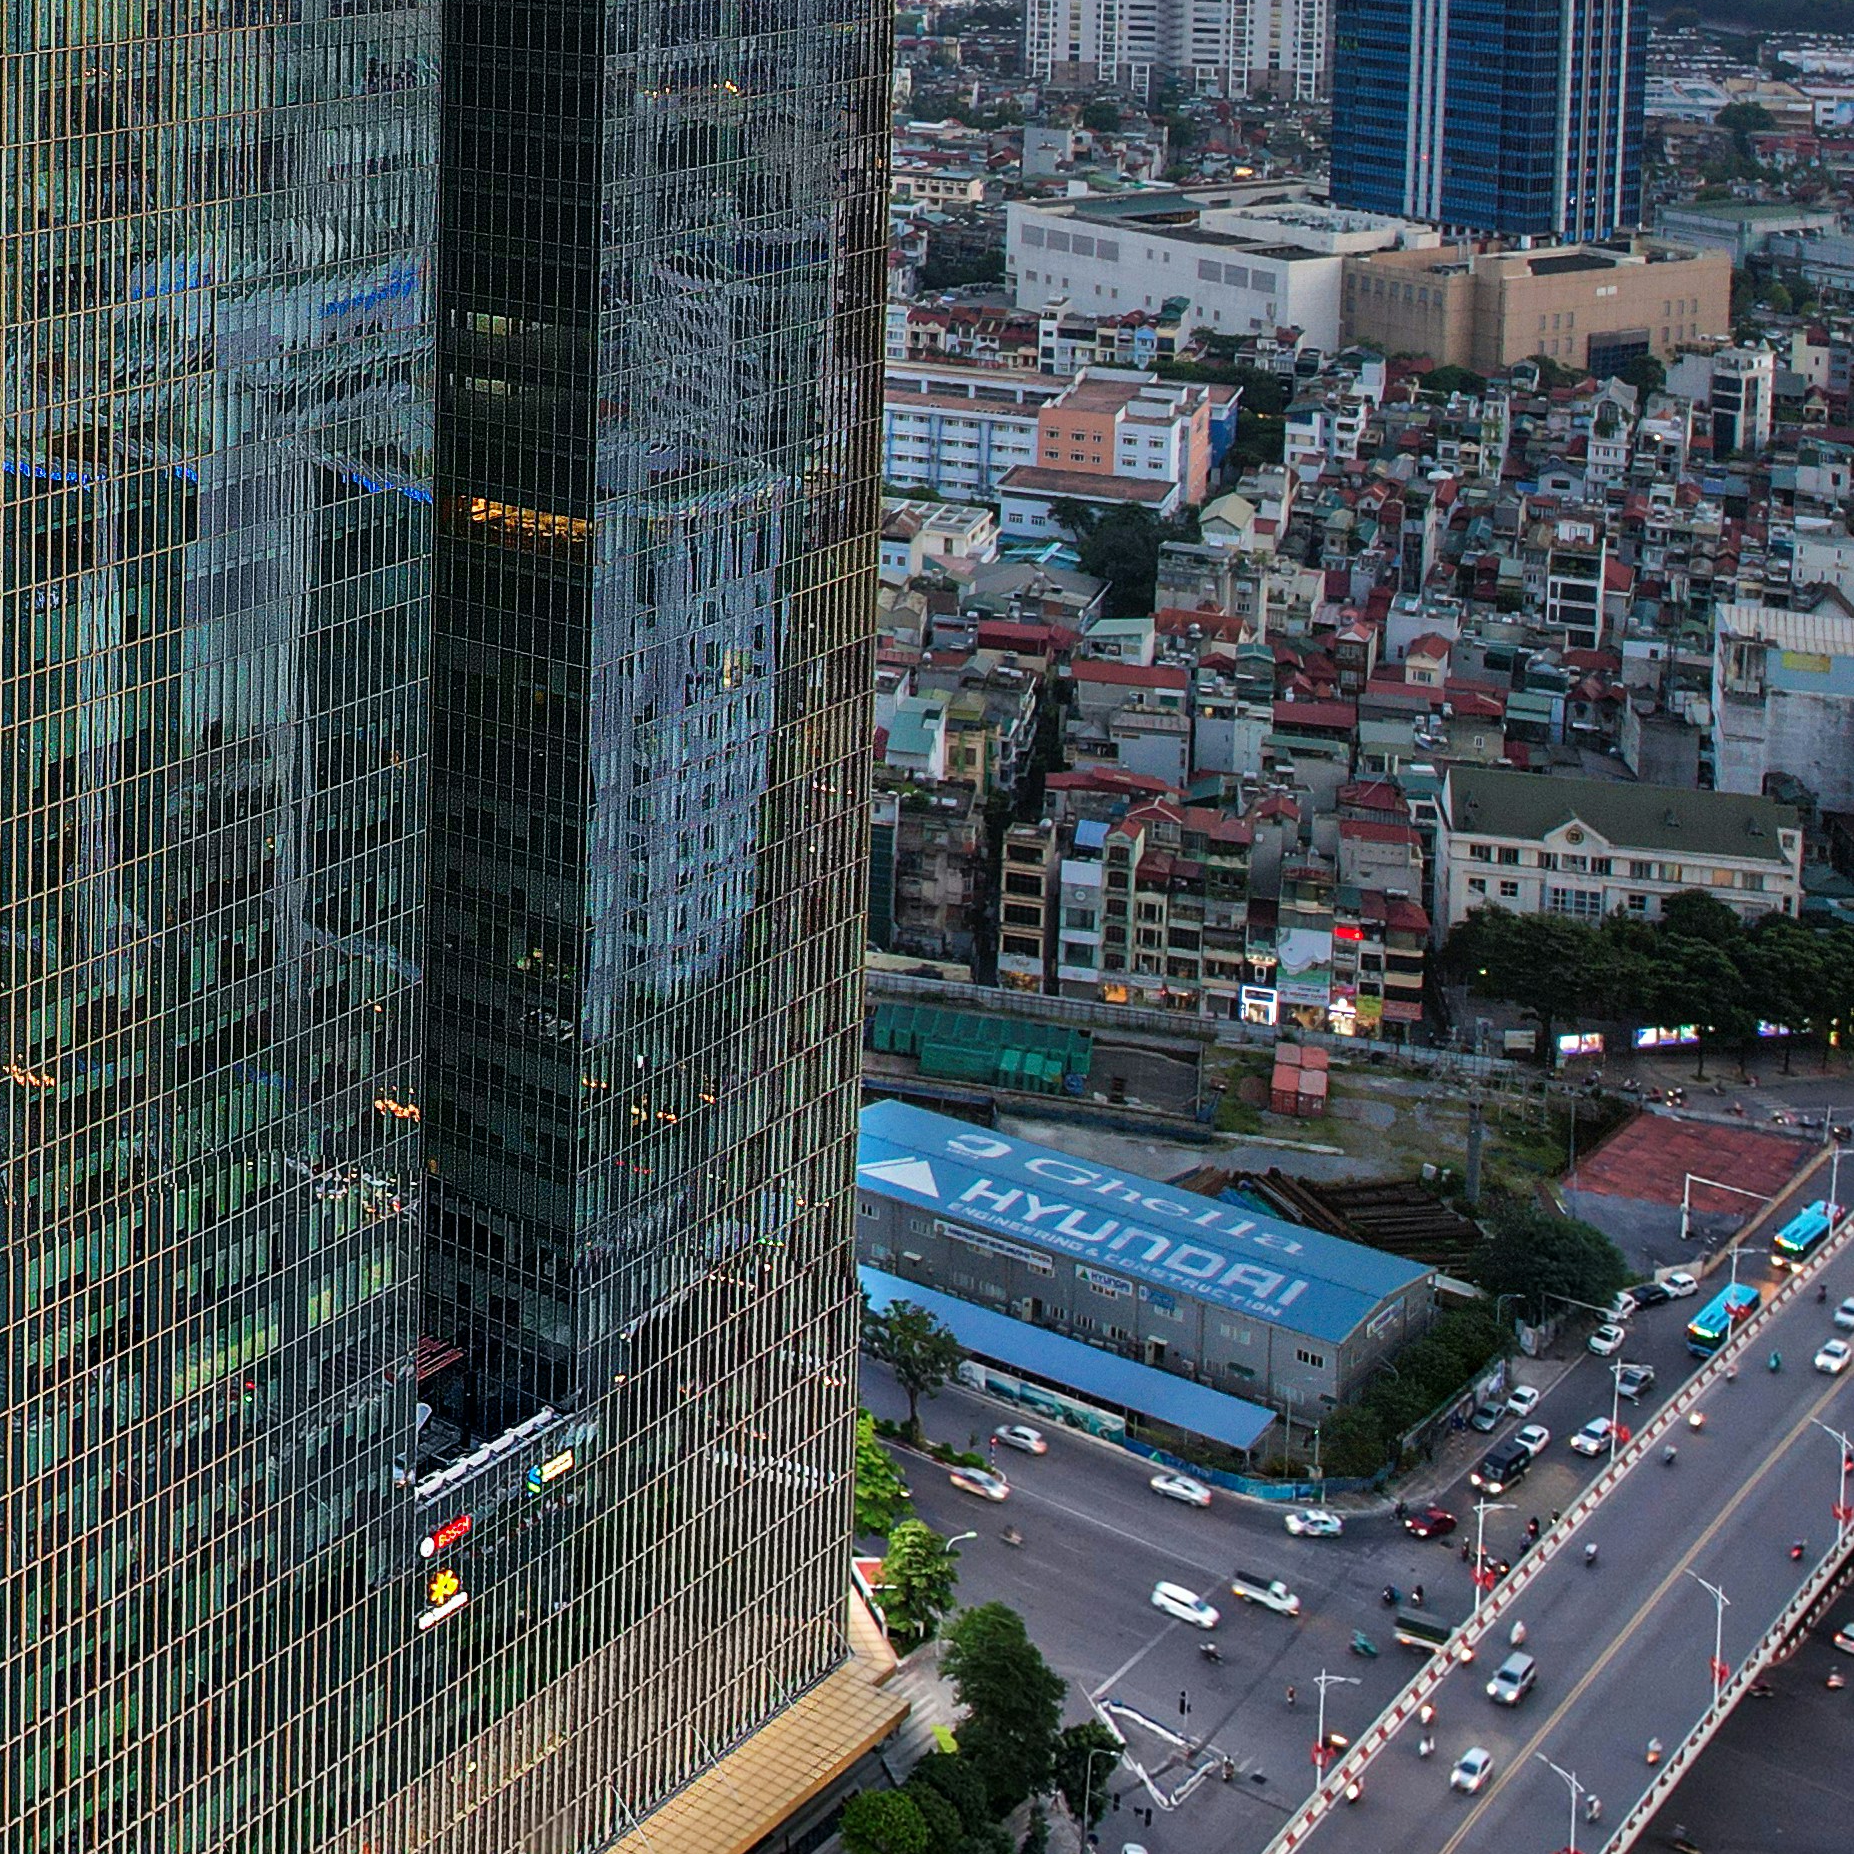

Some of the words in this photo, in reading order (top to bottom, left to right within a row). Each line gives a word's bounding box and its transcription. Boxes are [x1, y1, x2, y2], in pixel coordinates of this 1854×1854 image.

[947, 1202, 1085, 1252] ENGINEERING
[1103, 1253, 1283, 1317] CONSTRUCTION
[958, 1178, 1310, 1307] HYUNDAI
[1023, 1157, 1304, 1256] Ghella
